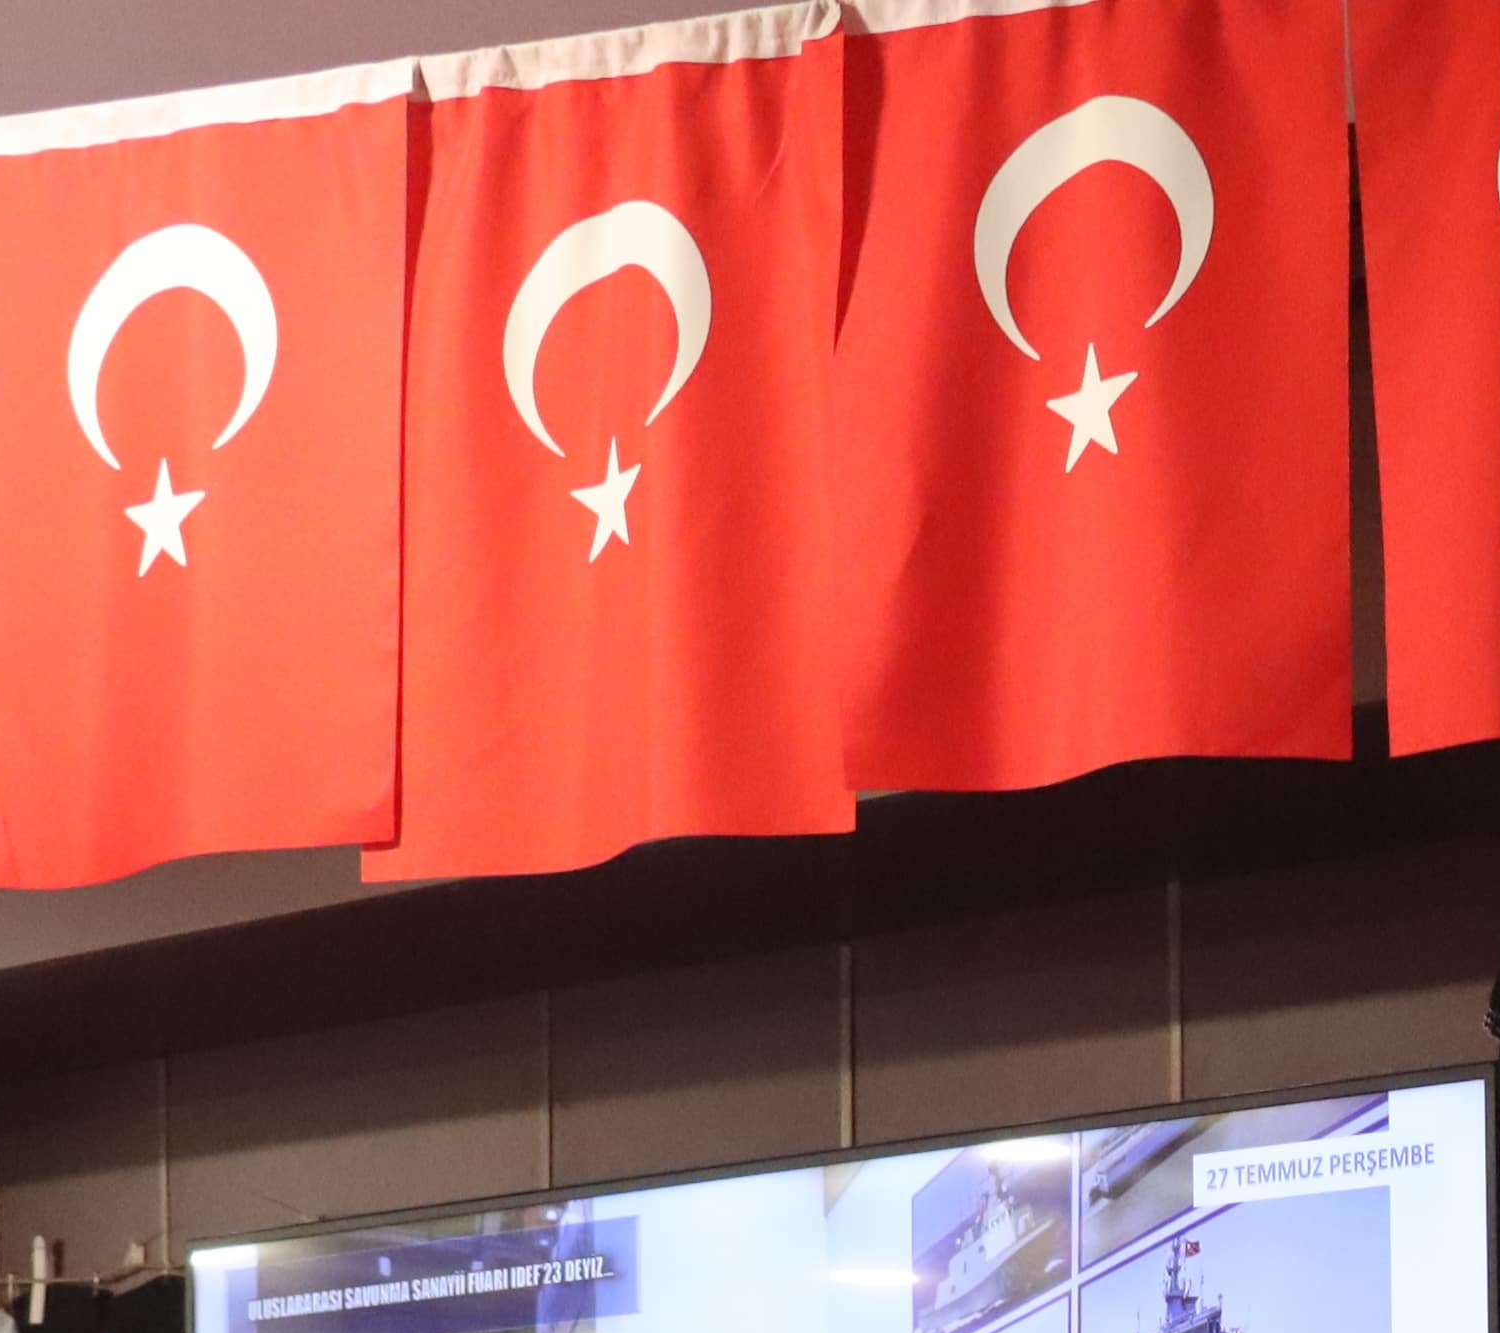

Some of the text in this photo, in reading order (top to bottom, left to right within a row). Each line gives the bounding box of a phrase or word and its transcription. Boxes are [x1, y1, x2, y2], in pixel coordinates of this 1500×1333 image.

[1206, 1143, 1435, 1190] 27 TEMMUZ PERŞEMBE
[248, 1289, 343, 1320] ULUSLARARASI
[344, 1281, 410, 1309] SAVUNMA
[467, 1268, 508, 1294] FUARI
